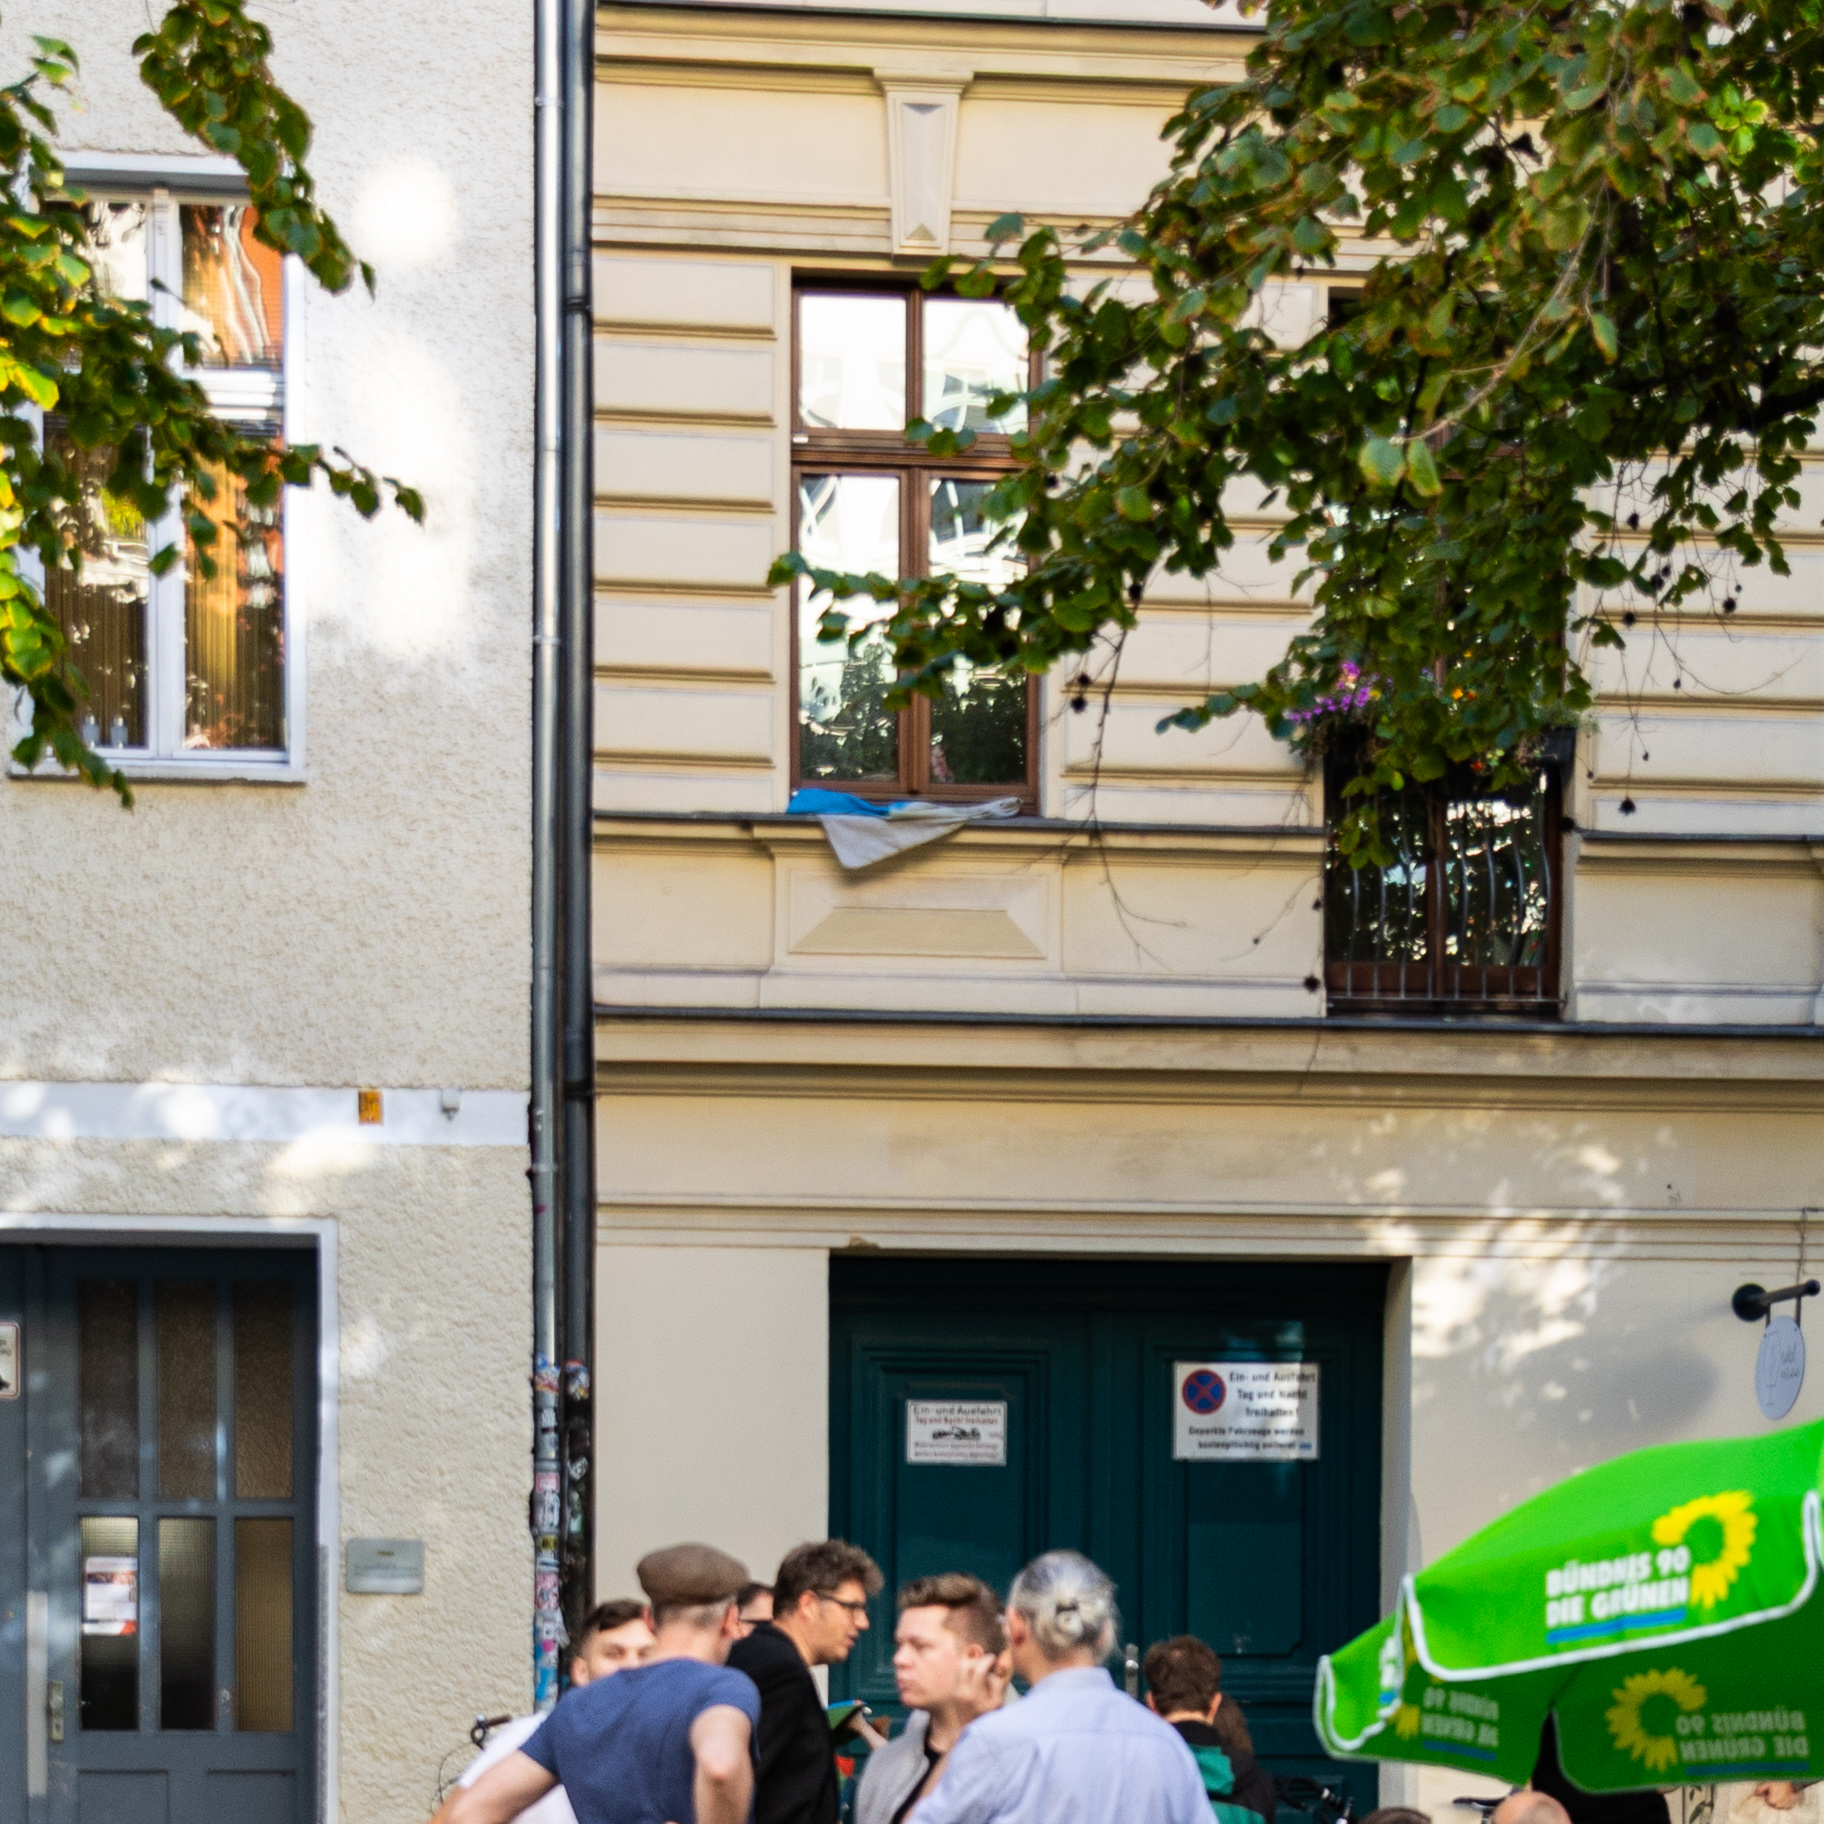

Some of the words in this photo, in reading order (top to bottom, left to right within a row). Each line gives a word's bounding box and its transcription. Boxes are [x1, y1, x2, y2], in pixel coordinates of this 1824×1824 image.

[1252, 1371, 1271, 1381] und
[1237, 1389, 1254, 1401] Tag
[1258, 1389, 1275, 1399] und
[1545, 1551, 1652, 1597] BÜNDNIS
[1656, 1545, 1691, 1577] 90
[1545, 1594, 1584, 1628] DIE
[1590, 1576, 1690, 1619] GRÜNEN
